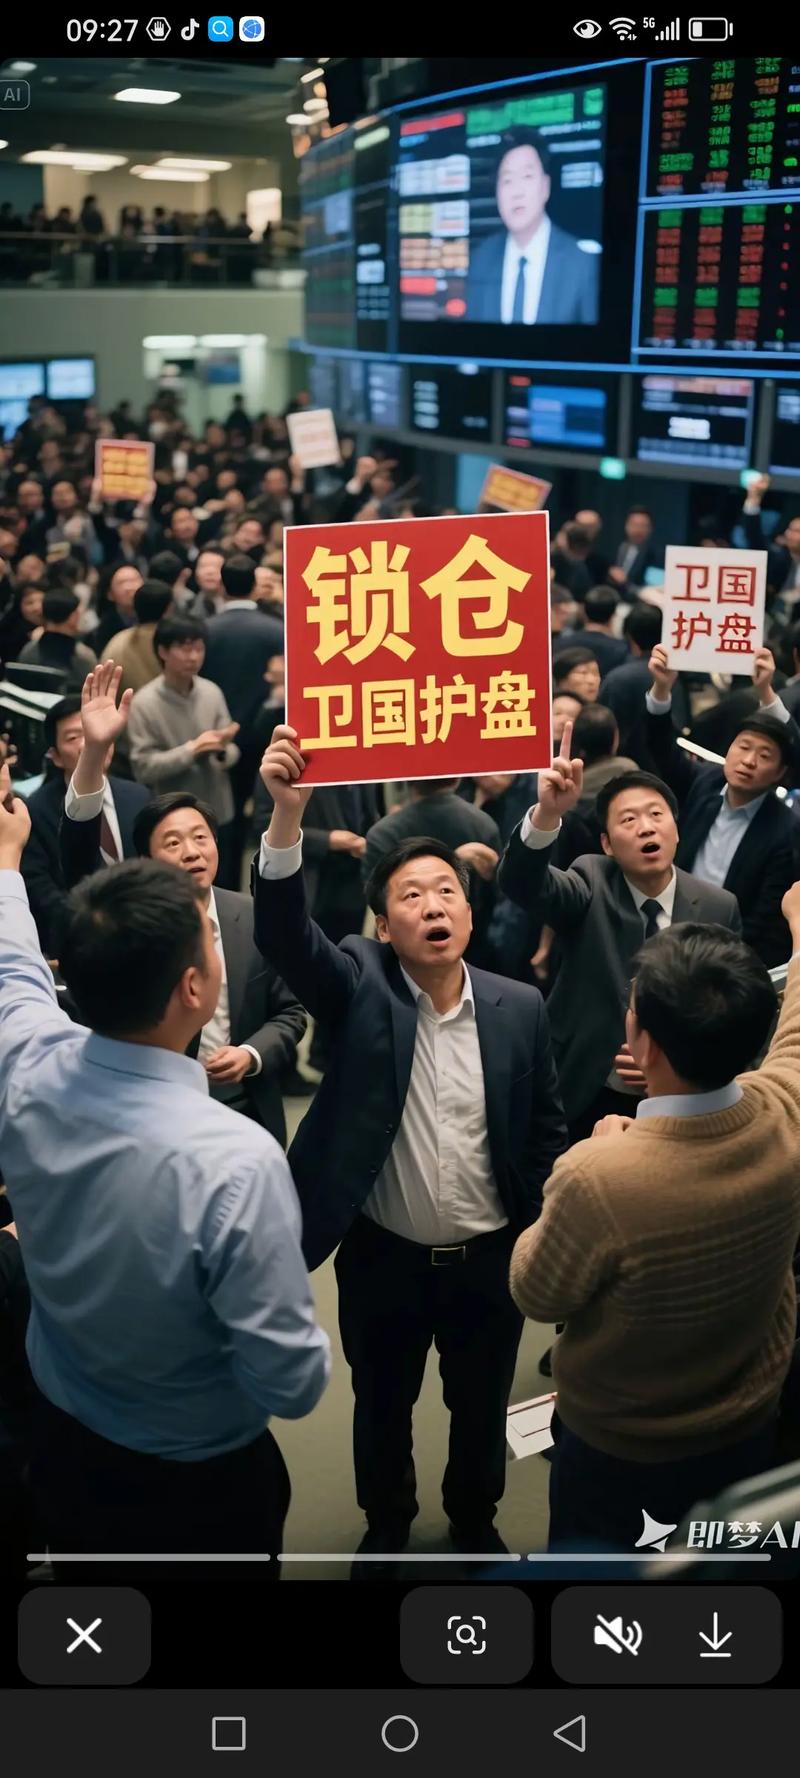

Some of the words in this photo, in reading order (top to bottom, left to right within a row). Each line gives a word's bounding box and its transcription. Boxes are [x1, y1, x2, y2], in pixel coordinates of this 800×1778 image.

[302, 534, 533, 666] 锁仓
[671, 564, 757, 606] 卫国
[671, 611, 757, 654] 护盘
[300, 670, 537, 750] 卫国护盘
